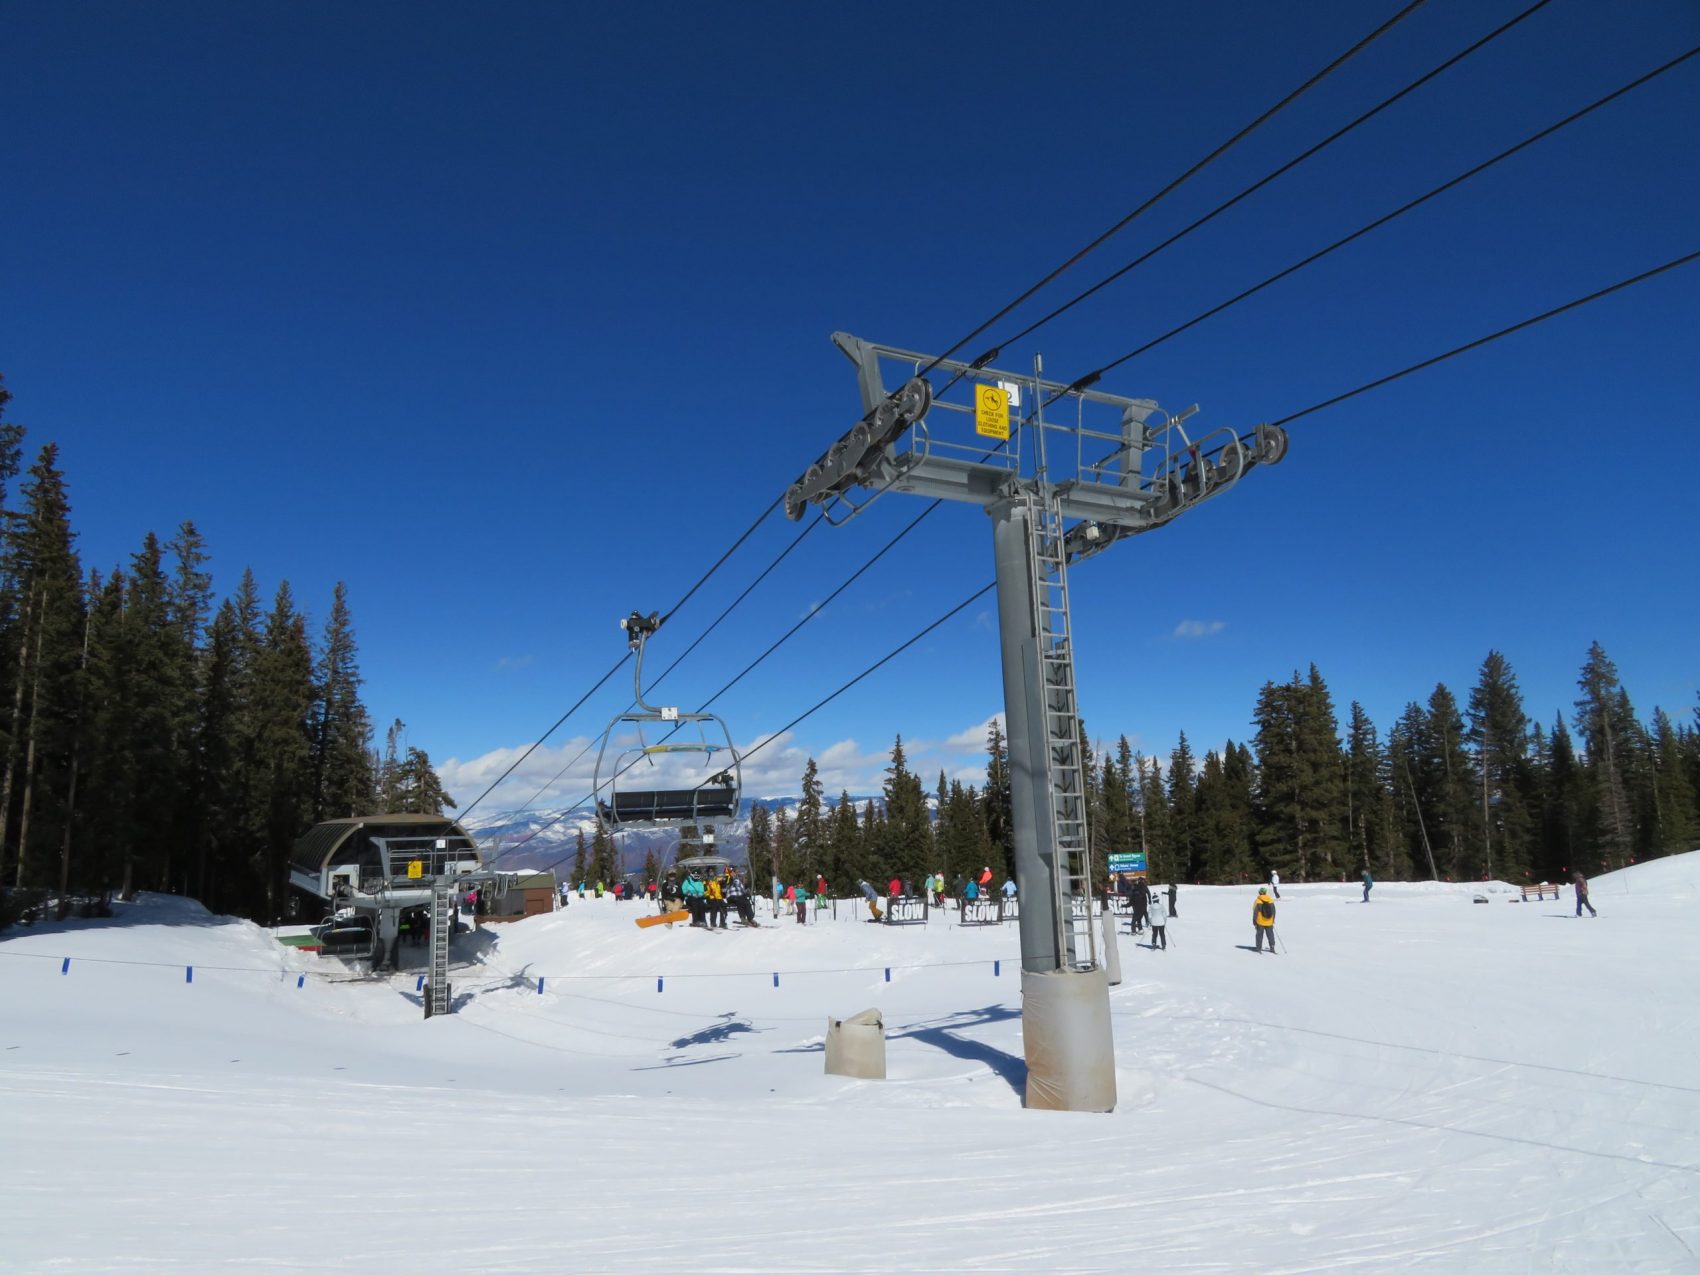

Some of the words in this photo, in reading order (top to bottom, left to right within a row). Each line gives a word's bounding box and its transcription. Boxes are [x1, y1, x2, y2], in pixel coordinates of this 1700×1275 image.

[978, 421, 997, 429] CLOTHING
[981, 427, 1004, 436] EQUIPMENT
[891, 903, 924, 921] SLOW
[965, 904, 999, 921] SLOW
